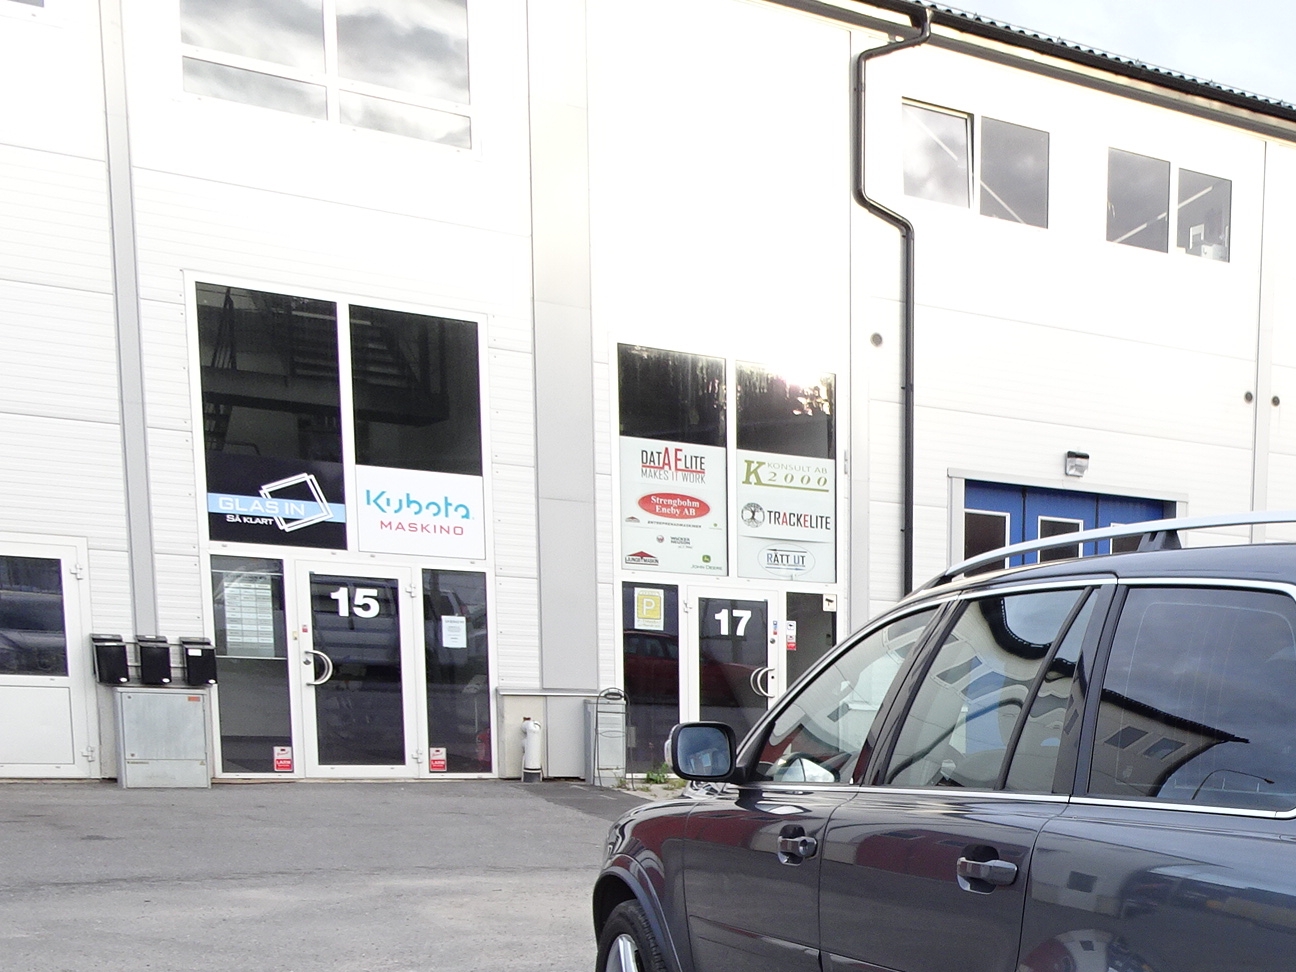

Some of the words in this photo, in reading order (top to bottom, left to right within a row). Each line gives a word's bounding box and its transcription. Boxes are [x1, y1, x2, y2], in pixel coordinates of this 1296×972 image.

[641, 467, 669, 480] MAKES
[672, 470, 679, 482] IT
[681, 472, 706, 484] WORK
[767, 462, 811, 473] KONSULT
[218, 496, 280, 514] GLAS
[285, 502, 305, 516] IN
[366, 489, 470, 520] Kubota
[651, 495, 700, 508] Strengbohm
[655, 505, 681, 516] Eneby
[683, 507, 696, 516] AB
[226, 514, 241, 523] SÅ
[242, 516, 274, 526] KLART
[380, 520, 464, 536] MASKINO
[767, 510, 831, 530] TRACKELITE
[766, 551, 790, 564] RÄTT
[793, 554, 806, 565] UT
[331, 587, 380, 618] 15
[714, 608, 752, 636] 17
